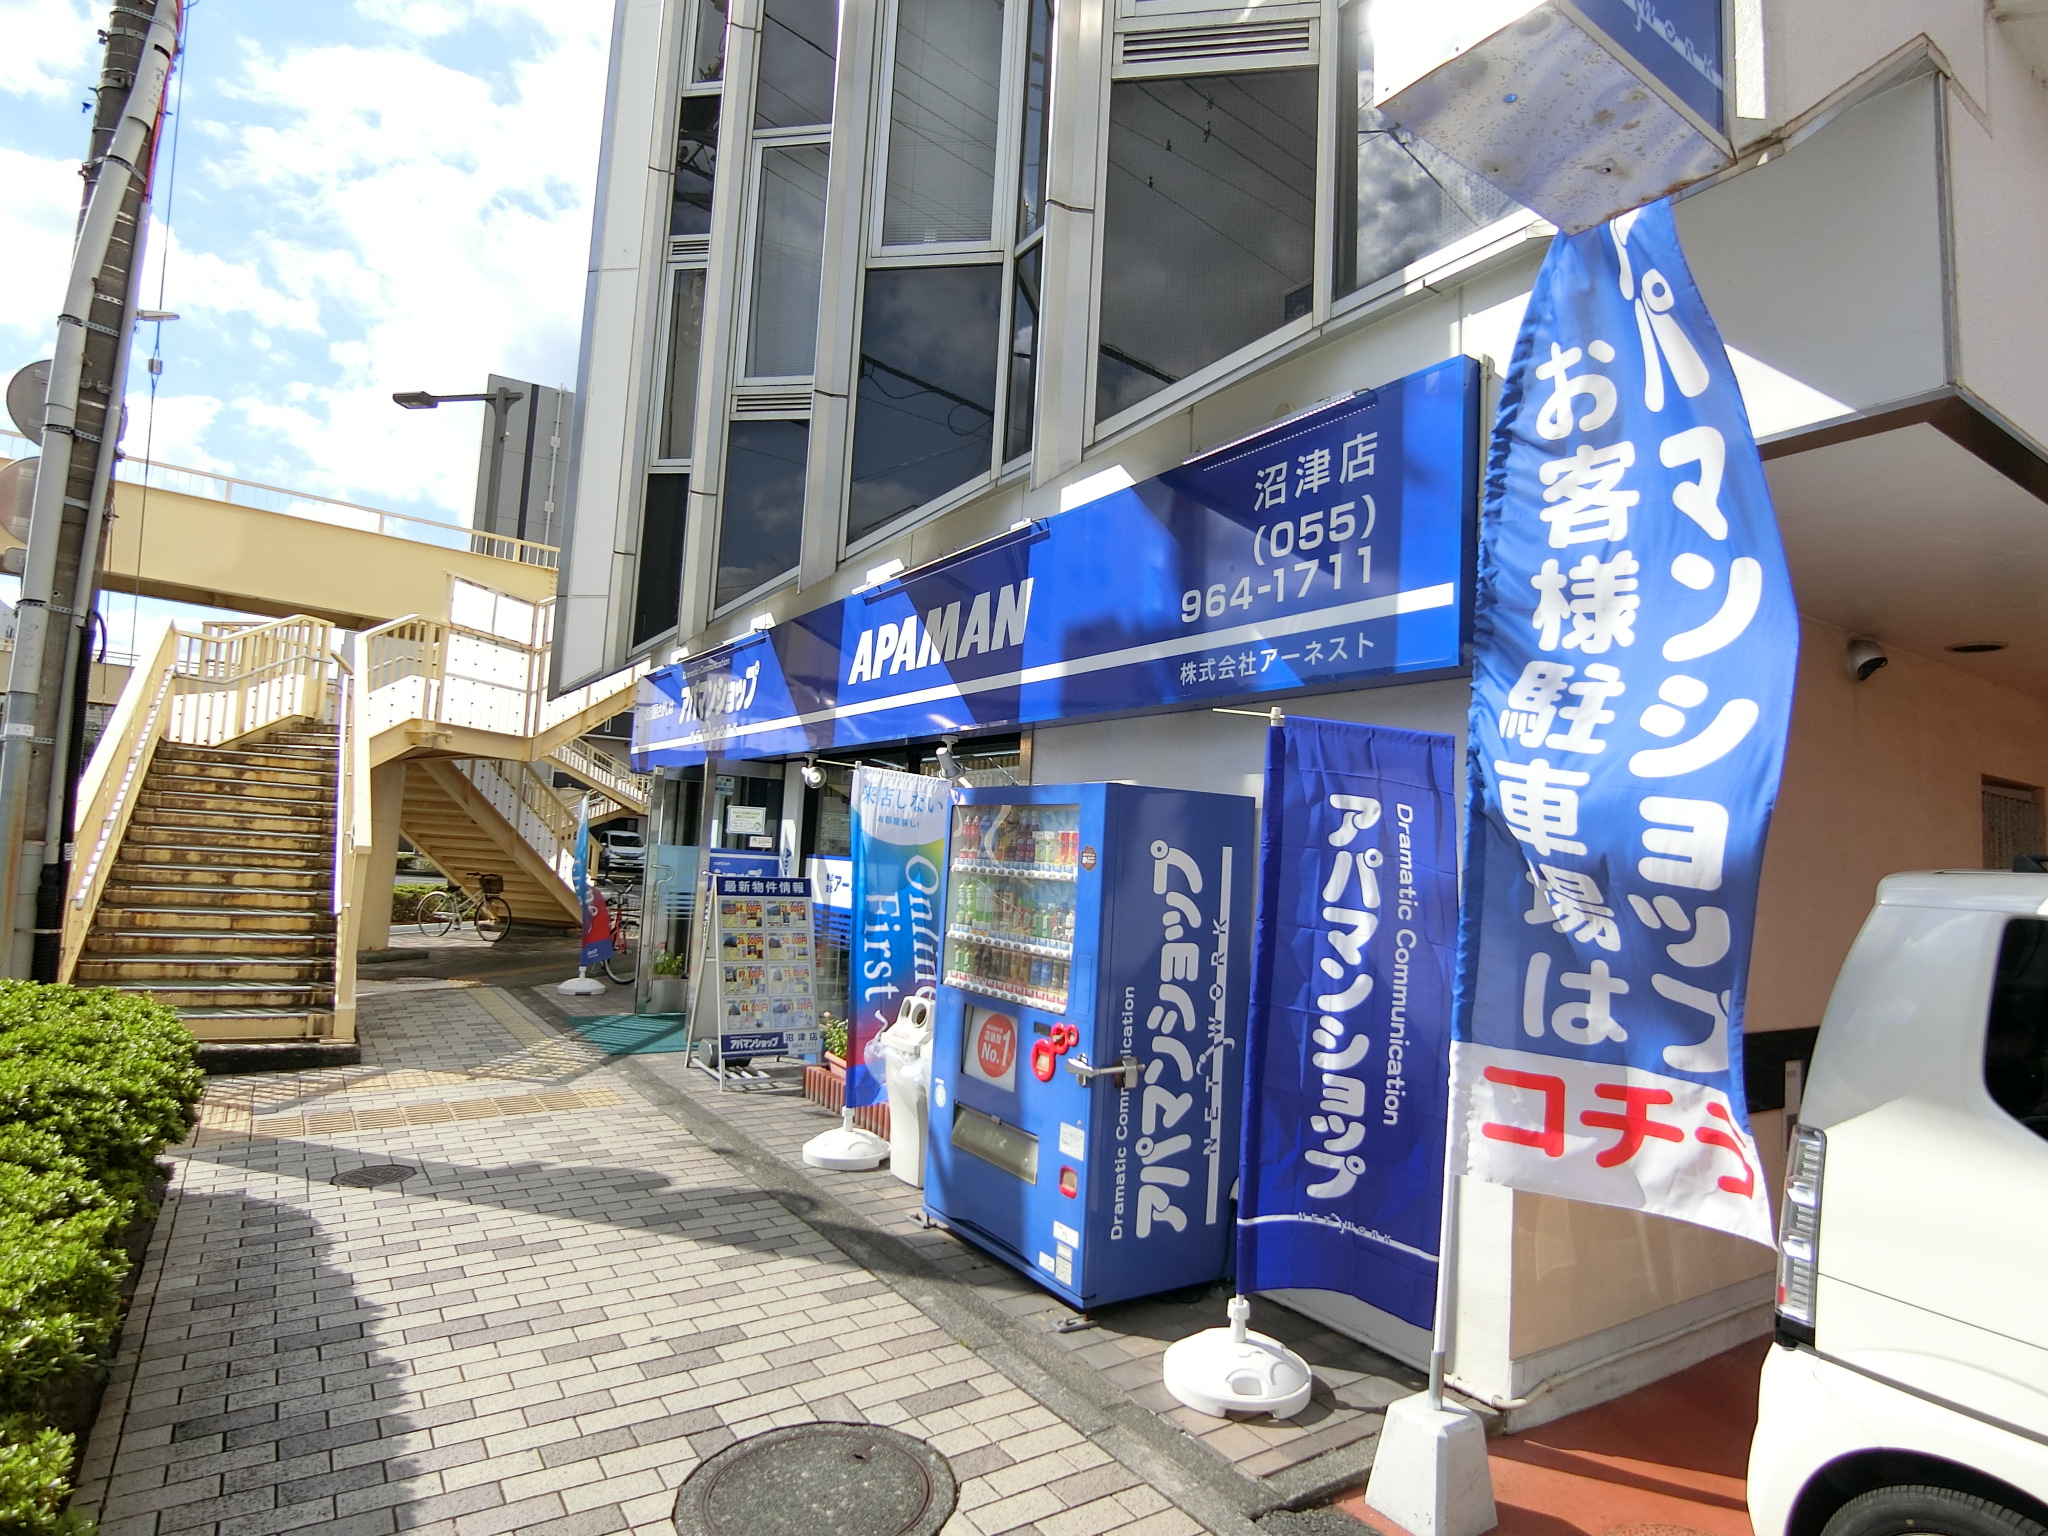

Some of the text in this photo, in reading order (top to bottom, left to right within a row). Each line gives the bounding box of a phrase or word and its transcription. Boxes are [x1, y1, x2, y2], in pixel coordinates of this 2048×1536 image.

[1253, 432, 1378, 511] 沼津店
[1254, 494, 1375, 565] (055)
[1181, 545, 1371, 623] 964-1711
[848, 577, 1034, 685] APAMAN
[1180, 632, 1374, 686] 株式会社アーネスト
[678, 660, 760, 724] アパマンショップ
[1494, 339, 1640, 1045] お客様駐車場は
[861, 783, 944, 814] 来店しない
[724, 880, 805, 893] 最新物件情報
[864, 892, 901, 1002] First
[1382, 802, 1417, 1125] Dramatic Communication
[1304, 794, 1383, 1198] アパマンショップ
[730, 1037, 779, 1049] アパマンショップ
[1136, 839, 1203, 1238] アパマンショップ
[1482, 1065, 1754, 1199] コチラ
[1111, 1152, 1127, 1240] Dramatic
